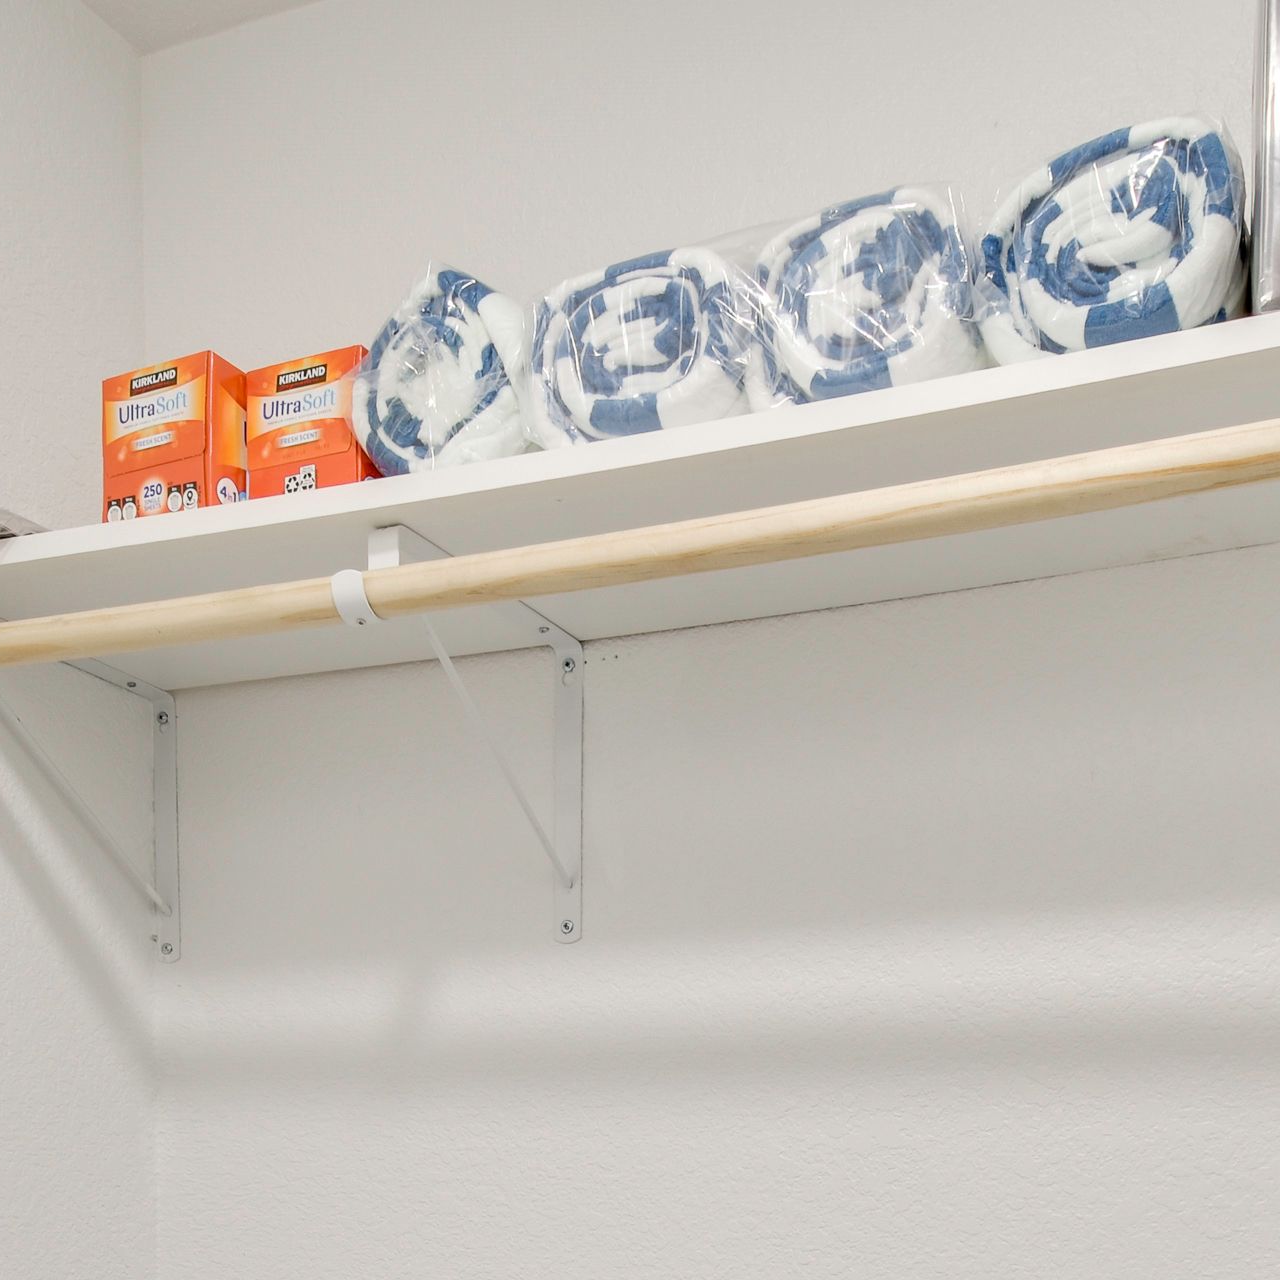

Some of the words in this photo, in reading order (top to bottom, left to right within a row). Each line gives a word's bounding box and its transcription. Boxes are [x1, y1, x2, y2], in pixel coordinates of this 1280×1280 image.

[132, 369, 176, 390] KIRKLAND
[278, 366, 326, 386] KIRKLAND
[144, 483, 163, 498] 250
